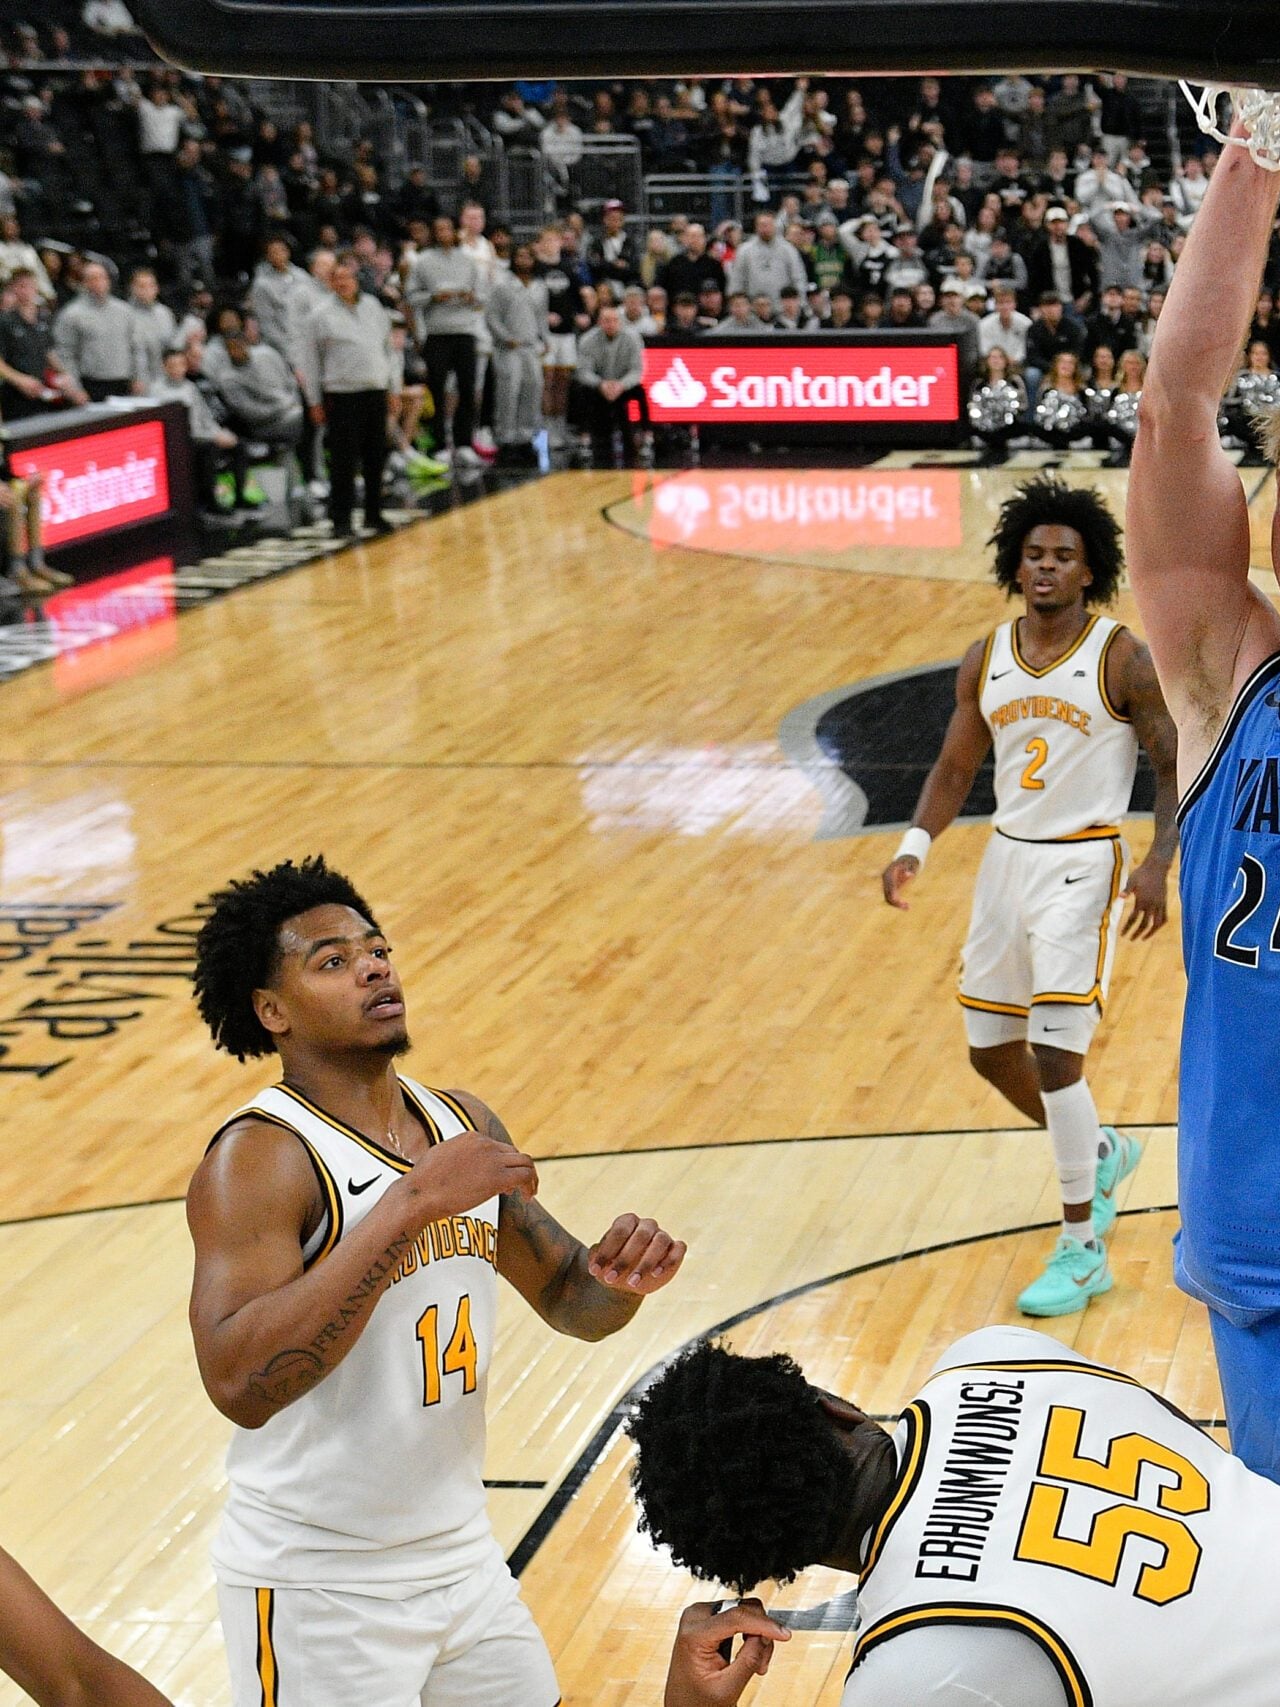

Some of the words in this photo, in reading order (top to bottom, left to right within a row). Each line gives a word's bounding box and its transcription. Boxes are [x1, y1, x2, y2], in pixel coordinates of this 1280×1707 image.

[711, 367, 938, 407] Santander
[989, 695, 1092, 737] PROVIDENCE
[1020, 737, 1049, 790] 2
[385, 1215, 499, 1289] OVIDENC
[311, 1231, 411, 1353] FRANKLIN
[416, 1293, 478, 1407] 14
[1013, 1405, 1211, 1607] 55
